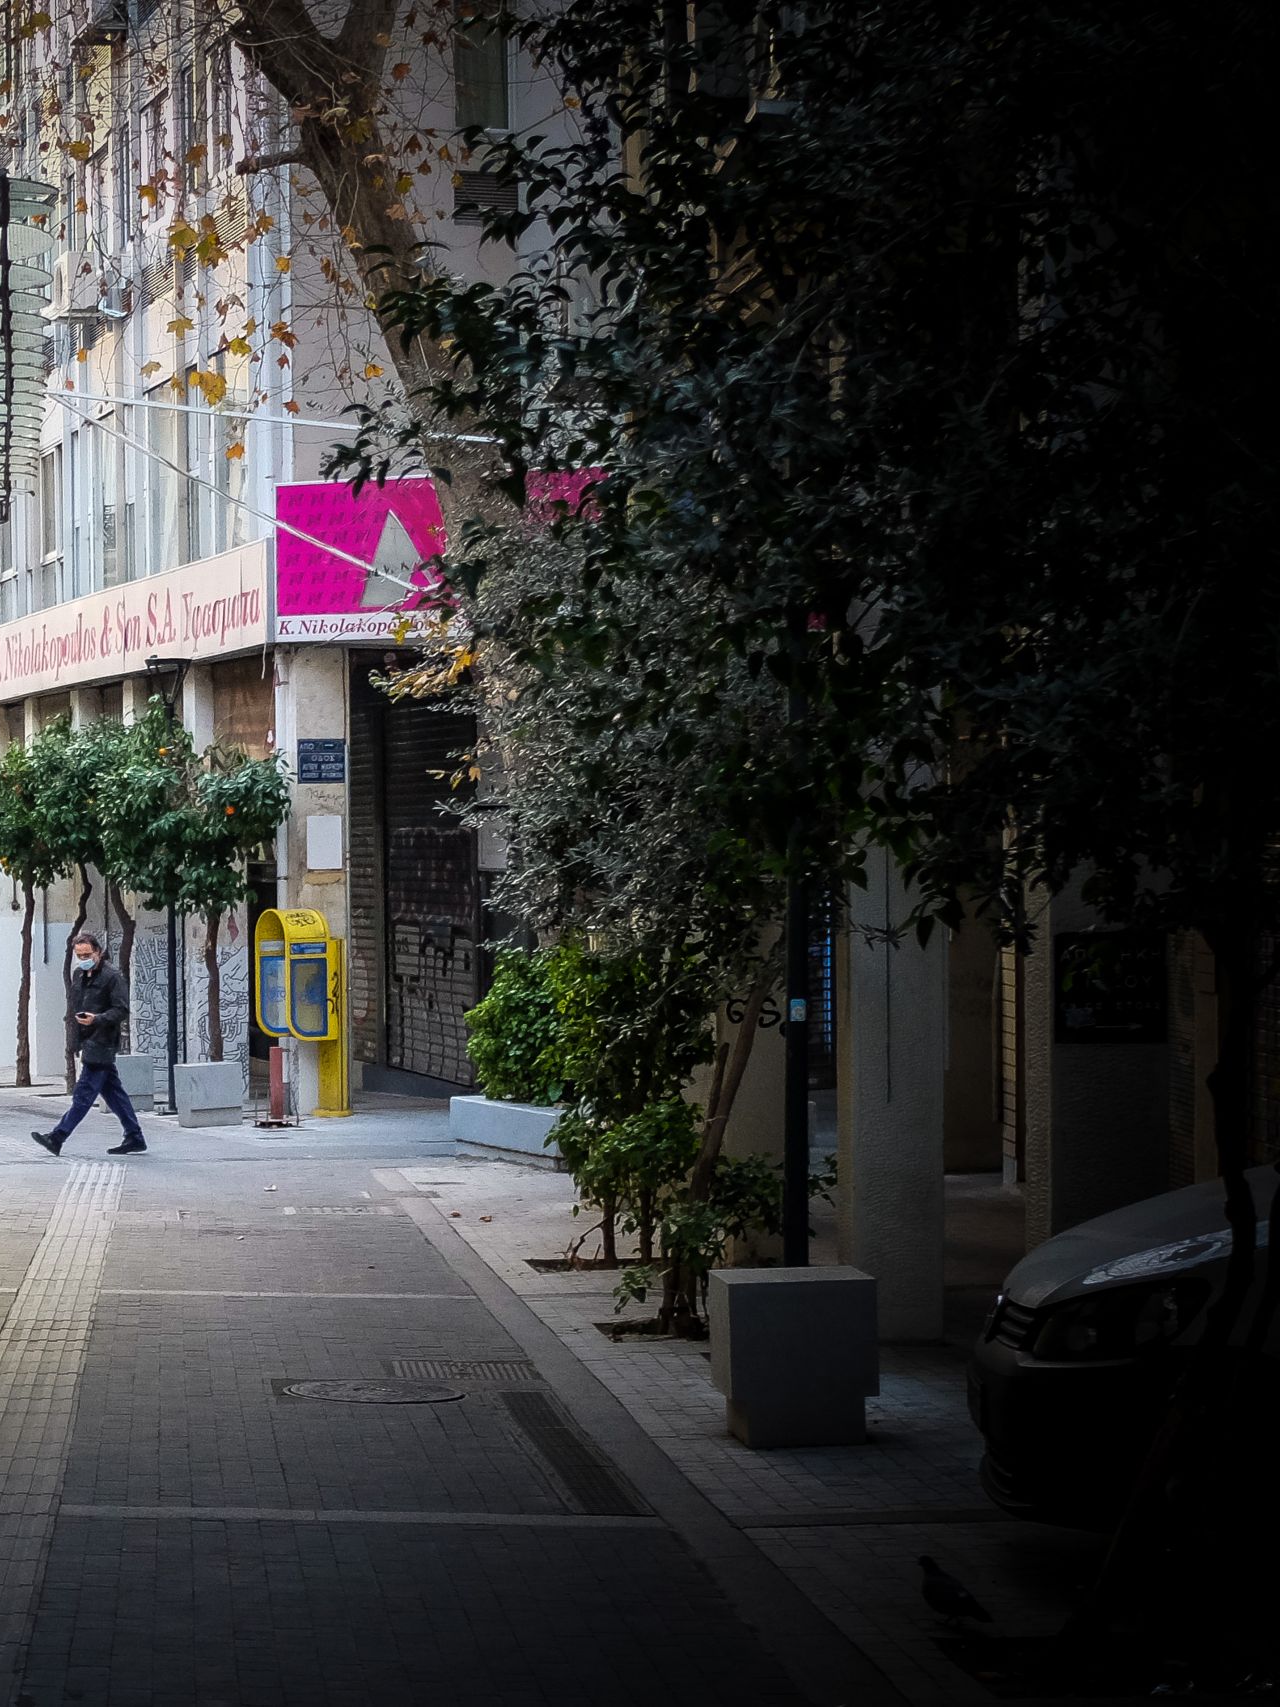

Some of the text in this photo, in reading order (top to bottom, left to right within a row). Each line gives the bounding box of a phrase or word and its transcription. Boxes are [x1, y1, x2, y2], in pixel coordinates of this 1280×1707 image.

[4, 612, 97, 681] Nikolakopoulos
[100, 605, 113, 657] &
[116, 601, 141, 655] Son
[145, 587, 176, 646] S.A.
[278, 620, 294, 635] K.
